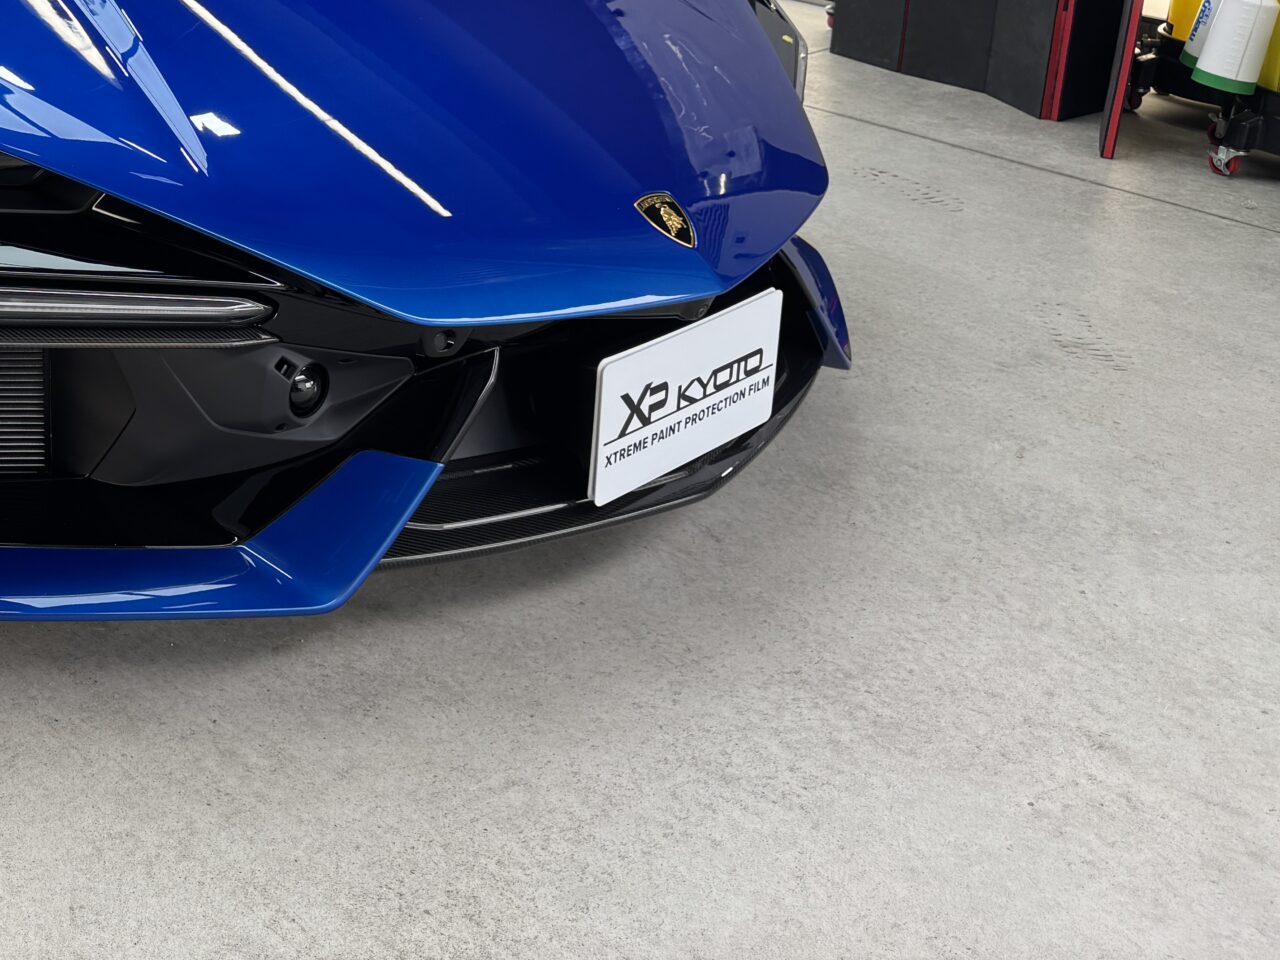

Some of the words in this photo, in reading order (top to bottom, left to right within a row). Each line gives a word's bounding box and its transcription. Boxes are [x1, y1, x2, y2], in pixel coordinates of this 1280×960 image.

[605, 437, 648, 468] XTREME
[651, 421, 682, 446] PAINT
[684, 387, 746, 429] PROTECTION
[748, 375, 770, 396] FILM
[618, 381, 669, 440] XP
[677, 347, 763, 411] KYOTO
